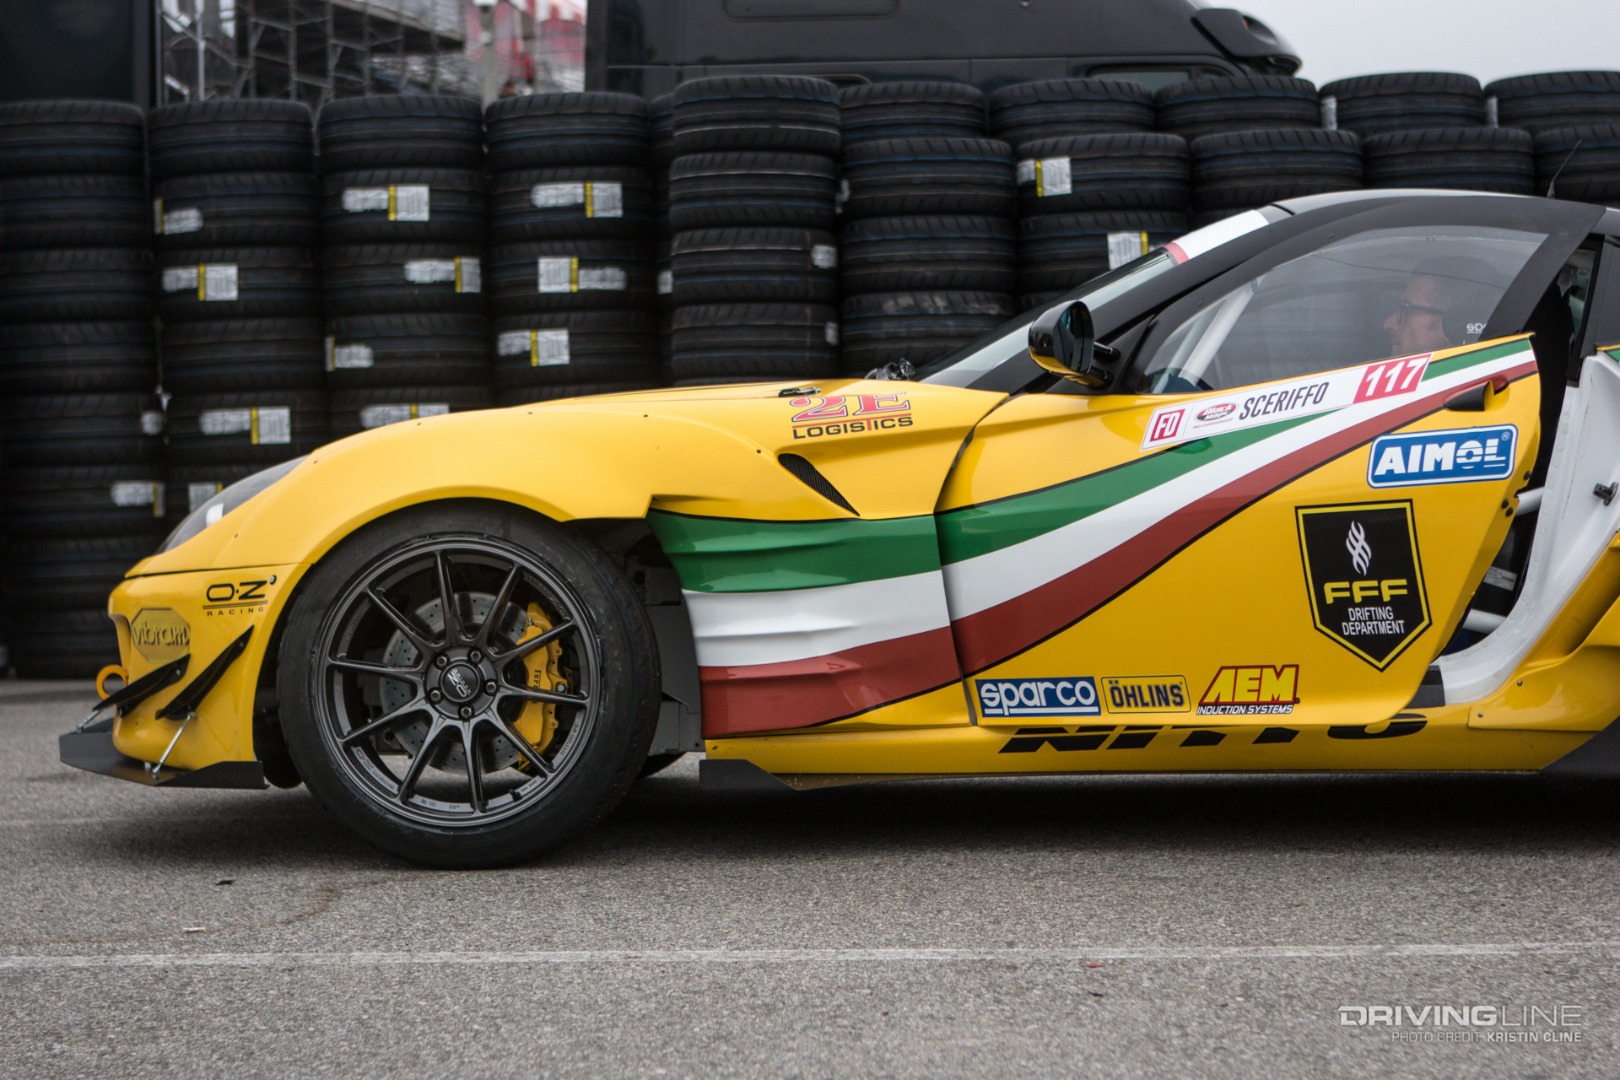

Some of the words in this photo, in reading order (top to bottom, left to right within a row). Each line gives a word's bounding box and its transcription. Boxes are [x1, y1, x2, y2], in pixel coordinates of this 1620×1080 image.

[1365, 357, 1420, 397] 117
[788, 391, 912, 422] 2E
[1239, 381, 1330, 421] SCERIFFO
[793, 416, 914, 439] LOGISTICS
[1374, 438, 1507, 476] AIMOL
[1323, 578, 1408, 605] FFF
[206, 606, 264, 616] RACING
[1347, 606, 1394, 622] DRIFTING
[1341, 620, 1405, 636] DEPARTMENT
[980, 680, 1097, 716] sparco
[1109, 679, 1185, 709] ÖHLINS
[1199, 664, 1300, 704] AEM
[1196, 704, 1246, 716] INDUCTION
[1248, 704, 1294, 715] SYSTEMS
